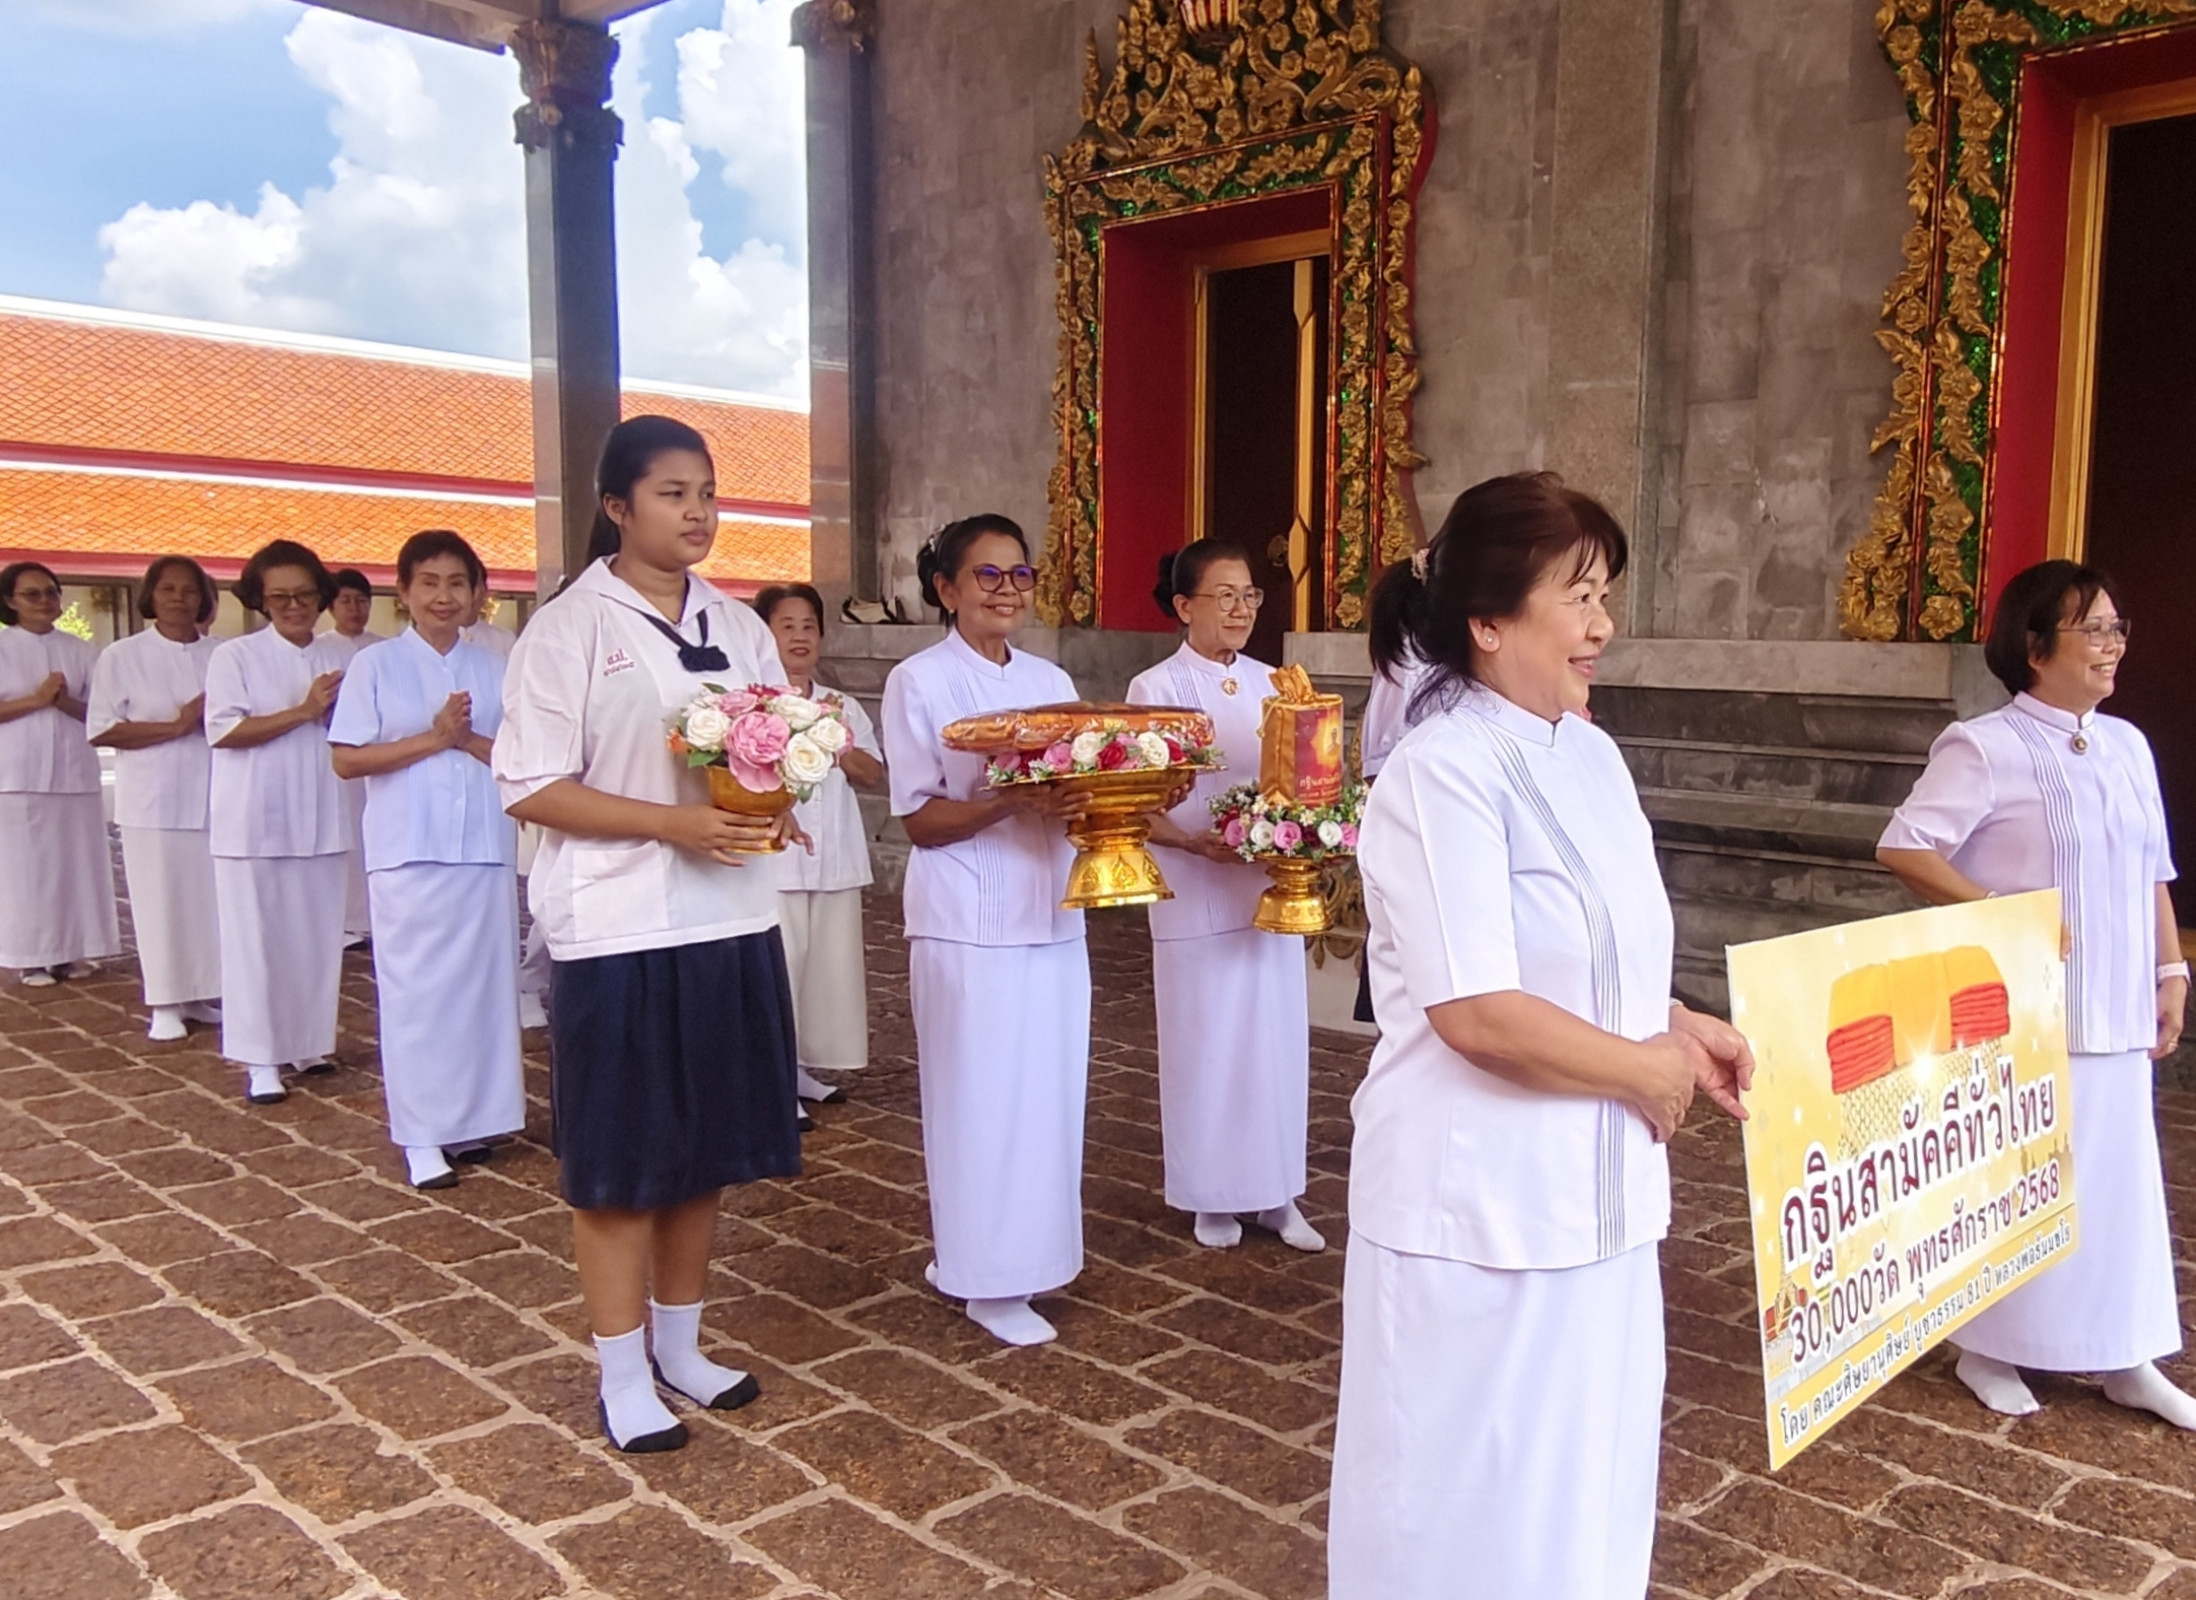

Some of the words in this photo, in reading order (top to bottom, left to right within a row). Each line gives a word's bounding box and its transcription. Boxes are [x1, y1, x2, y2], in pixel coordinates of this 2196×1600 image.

[1783, 1057, 2056, 1280] กฐินสามัคคีทั่วไทย
[1791, 1243, 1900, 1363] 30,000วัด
[1906, 1191, 2011, 1299] พุทธศักราช
[2017, 1163, 2060, 1218] 2568
[1780, 1407, 1809, 1444] โดย
[1813, 1316, 1910, 1421] คณะศิษยานุศิษย์
[1914, 1294, 1964, 1351] บูชาธรรม
[1966, 1279, 1981, 1305] 81
[1983, 1264, 1991, 1293] ปี
[1995, 1218, 2070, 1286] หลวงพ่อธัมมชโย
